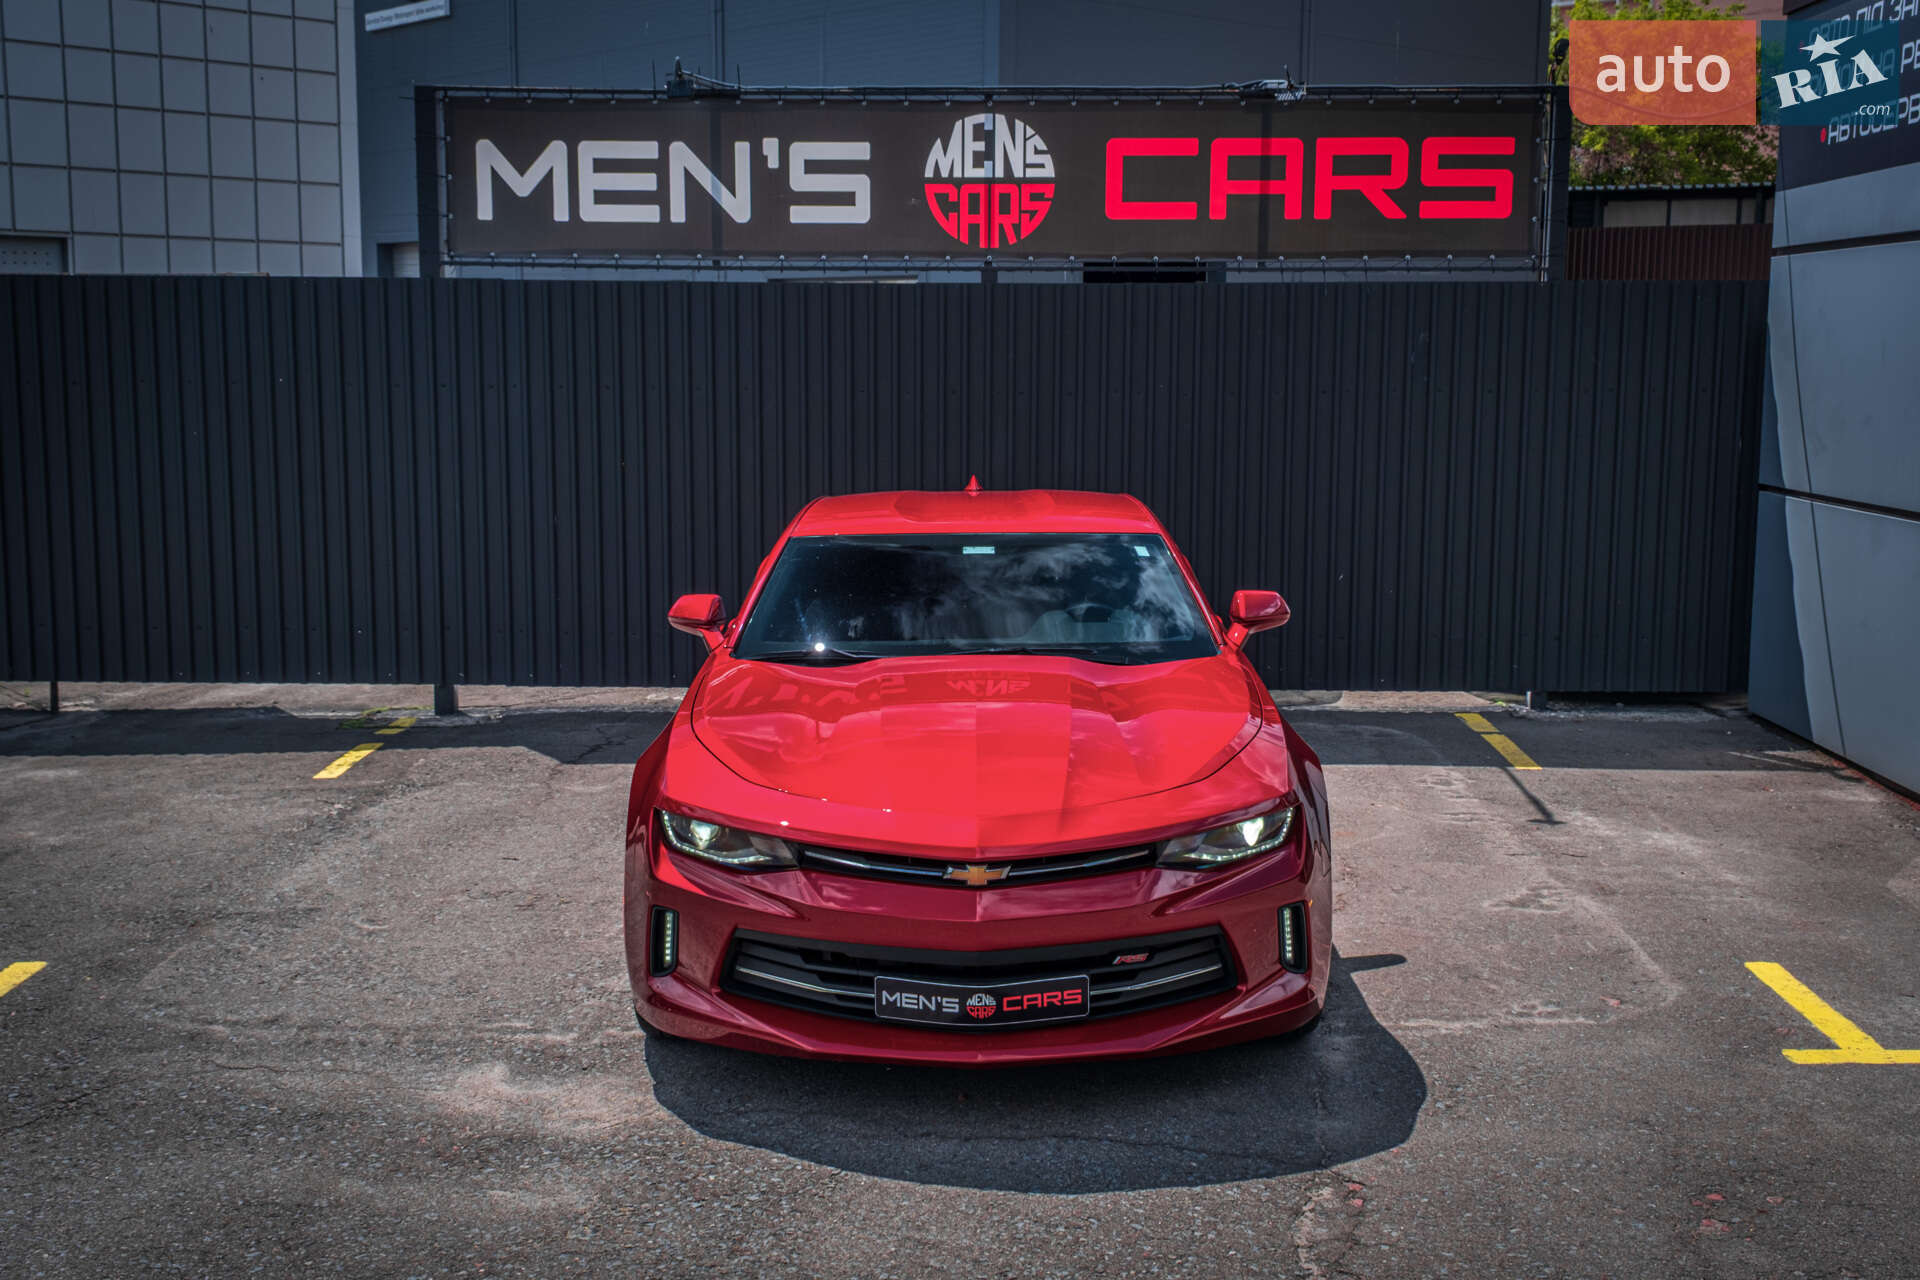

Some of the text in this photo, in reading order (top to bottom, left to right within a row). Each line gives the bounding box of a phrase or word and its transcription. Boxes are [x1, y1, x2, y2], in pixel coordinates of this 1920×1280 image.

[924, 113, 1056, 178] MEN'S
[475, 136, 1516, 224] MEN'S CARS
[924, 183, 1056, 249] CARS
[881, 989, 1083, 1013] MEN'S CARS
